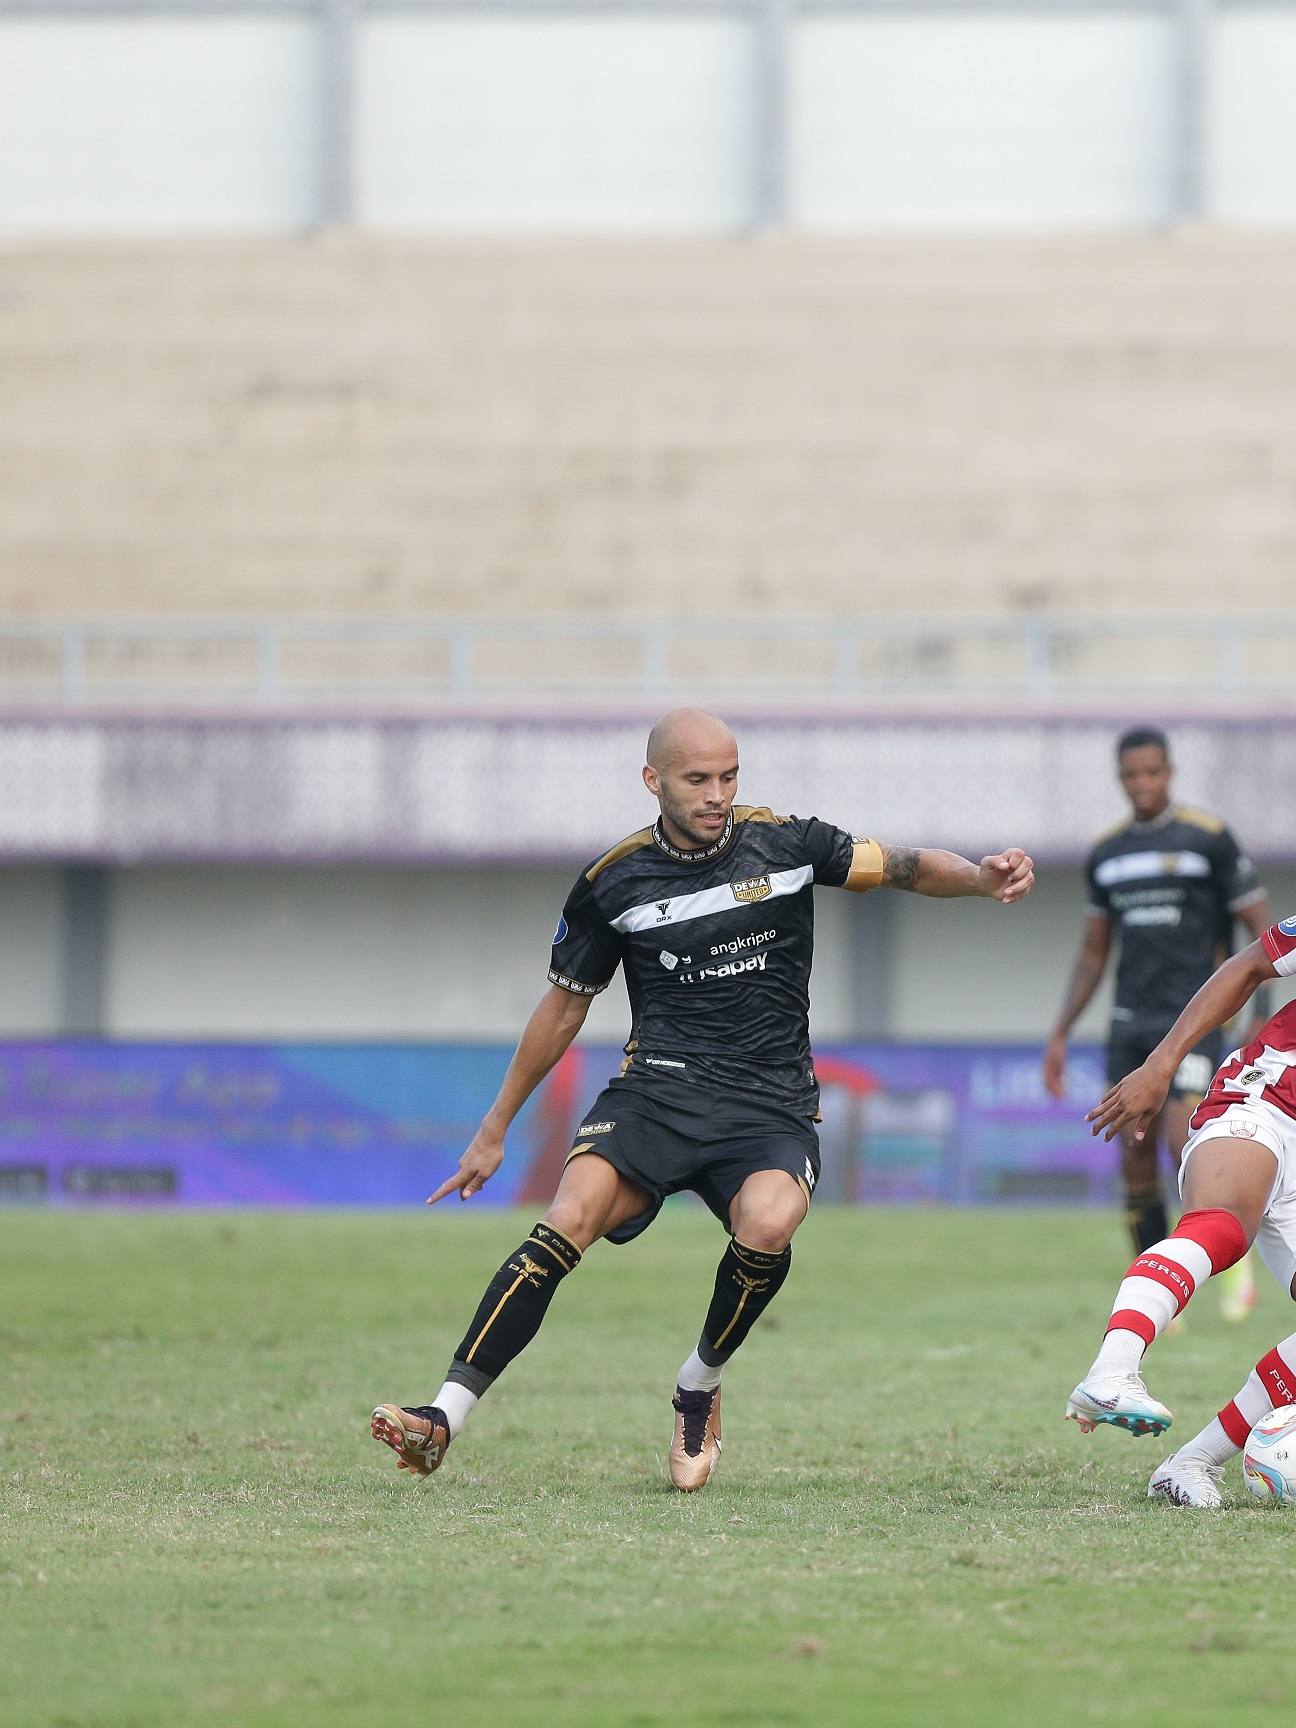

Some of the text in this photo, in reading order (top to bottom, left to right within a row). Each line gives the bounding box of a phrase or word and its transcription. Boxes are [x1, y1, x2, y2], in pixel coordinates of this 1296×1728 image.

[733, 878, 768, 893] DEWA
[742, 887, 764, 898] UNITED
[656, 914, 673, 923] DRX
[551, 1238, 573, 1258] DRX
[508, 1263, 542, 1289] DRX
[1135, 1259, 1190, 1298] PERSIS
